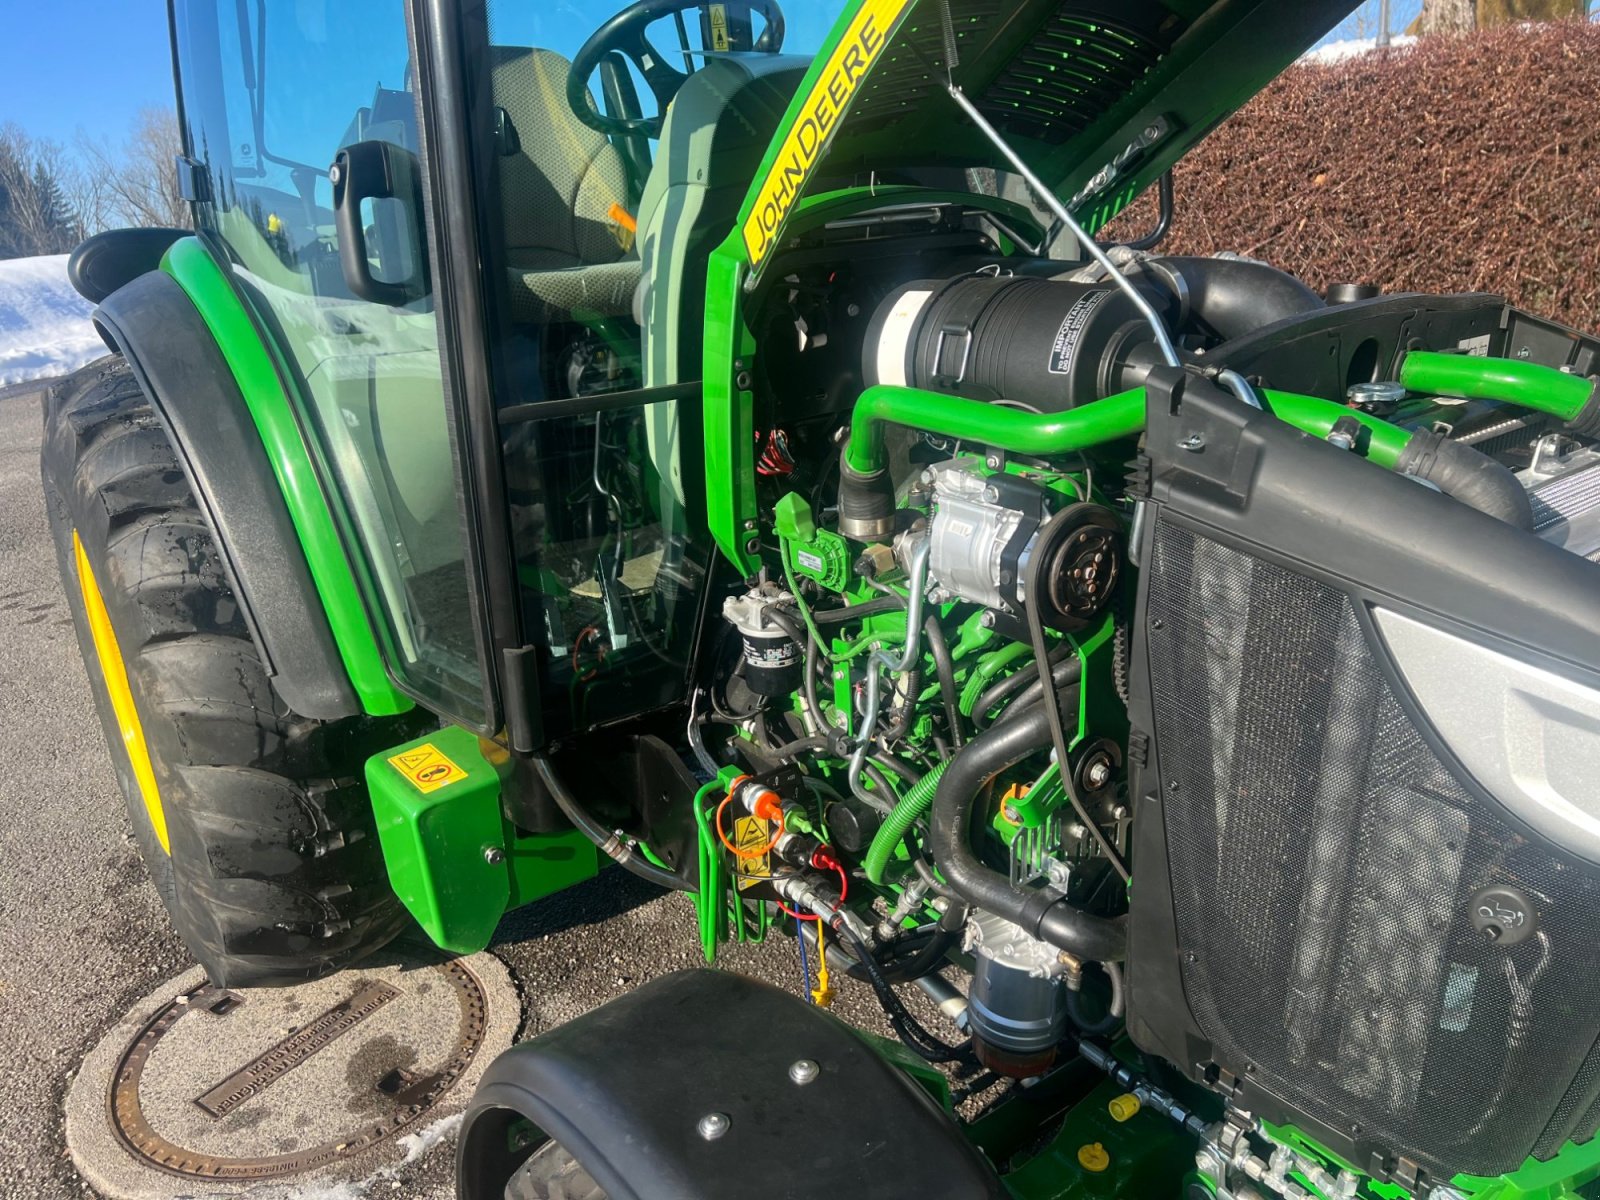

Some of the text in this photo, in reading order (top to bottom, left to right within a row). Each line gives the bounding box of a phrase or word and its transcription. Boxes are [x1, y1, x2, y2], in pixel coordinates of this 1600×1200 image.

[756, 13, 883, 252] JOHN DEERE
[1054, 300, 1087, 353] IMPORTANT
[1060, 330, 1073, 359] PREVENT
[1070, 308, 1086, 329] ENGINE
[1076, 302, 1095, 329] STARTING
